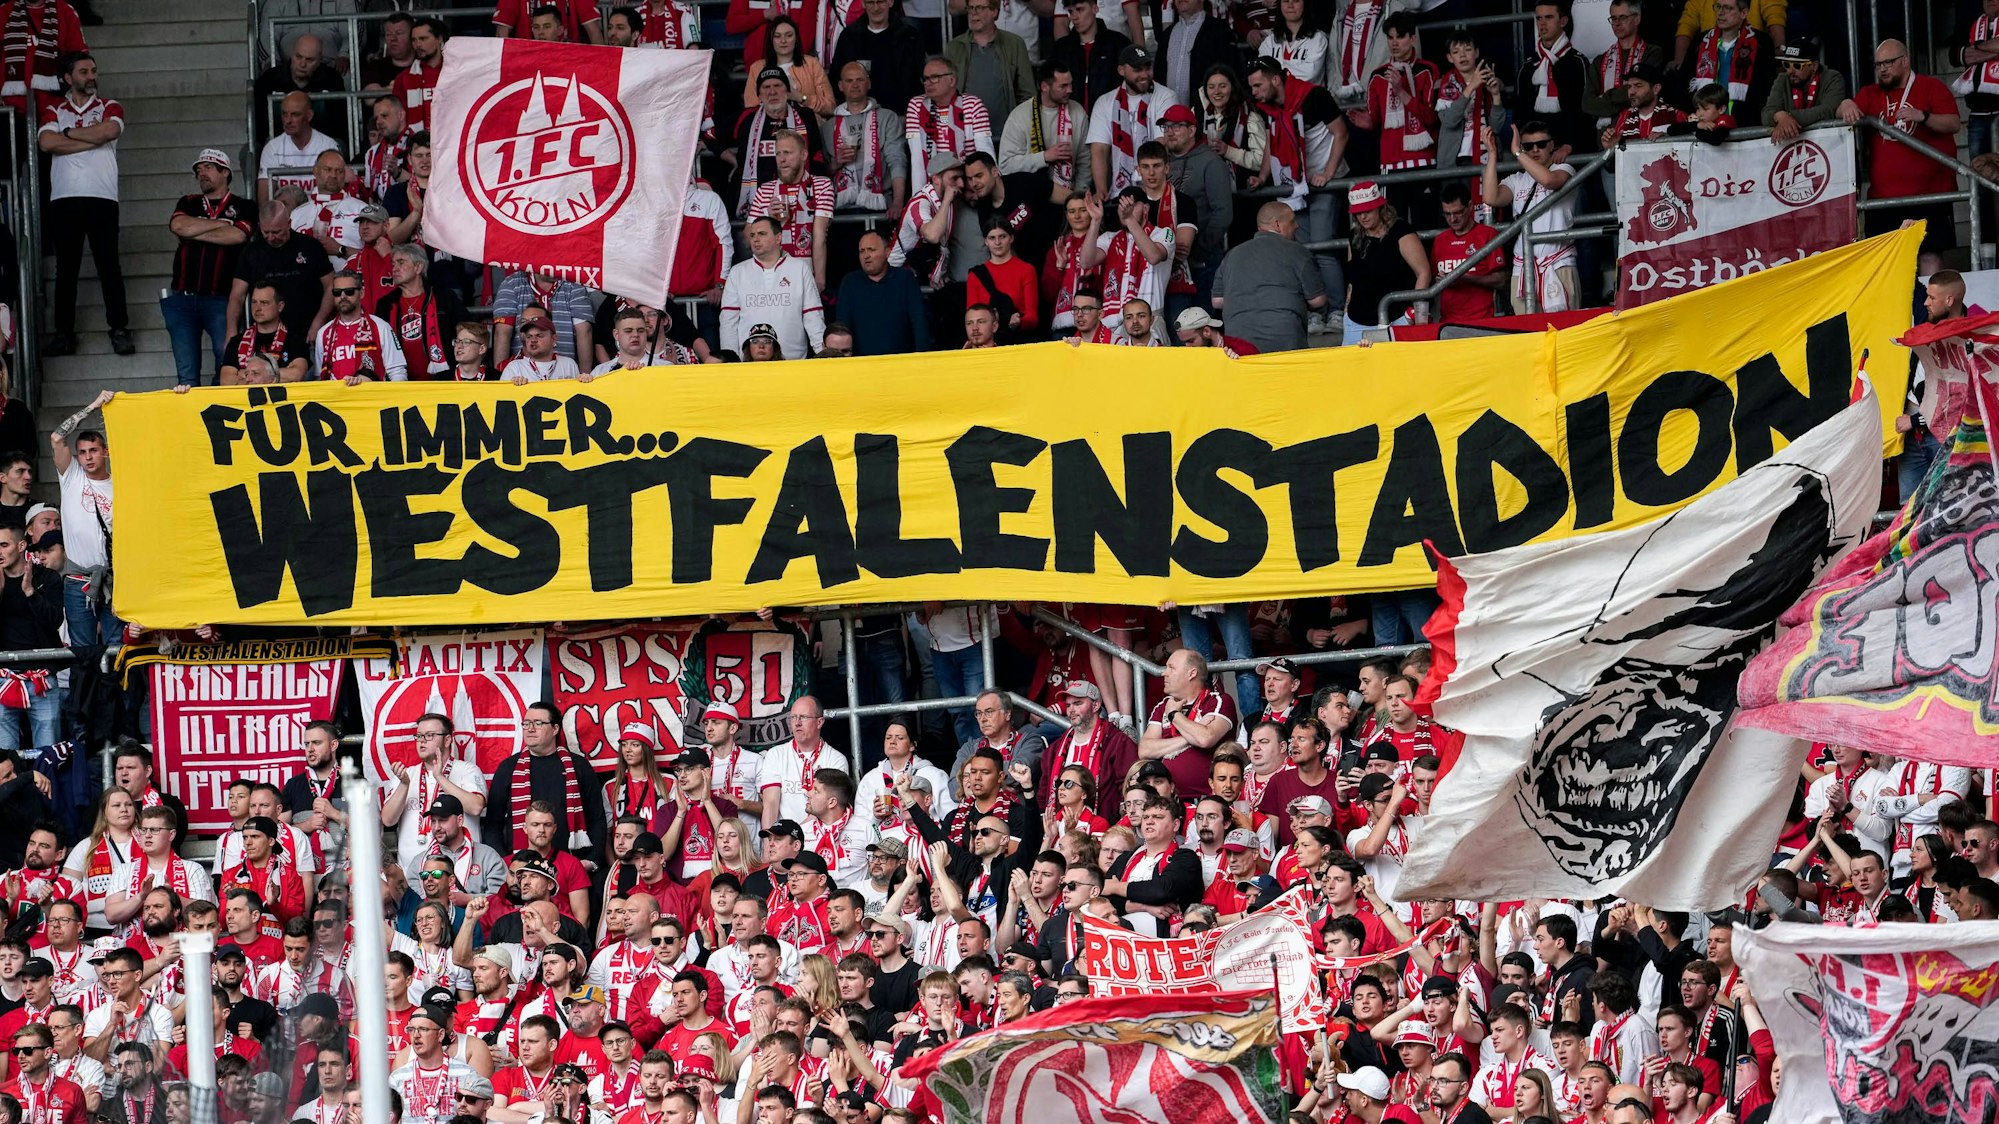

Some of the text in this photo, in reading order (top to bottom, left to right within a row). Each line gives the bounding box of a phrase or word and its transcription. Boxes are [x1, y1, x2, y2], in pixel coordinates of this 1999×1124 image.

[494, 123, 600, 186] 1.FC
[758, 141, 776, 157] RE
[1700, 174, 1756, 198] Die
[1779, 157, 1817, 189] 1.FC
[499, 189, 593, 225] KÖLN
[1784, 187, 1815, 202] KÖLN
[487, 261, 600, 287] OTIX
[746, 292, 792, 308] REWE
[201, 387, 680, 470] FÜR IMMER...
[209, 311, 1852, 618] WESTFALENSTADION
[169, 637, 351, 661] WESTFALENSTADION
[558, 633, 681, 694] SPS
[162, 661, 331, 702] RASCALS
[713, 650, 785, 704] 51
[179, 711, 312, 756] ULTRAS
[783, 780, 804, 795] RE
[1084, 936, 1204, 983] ROTE
